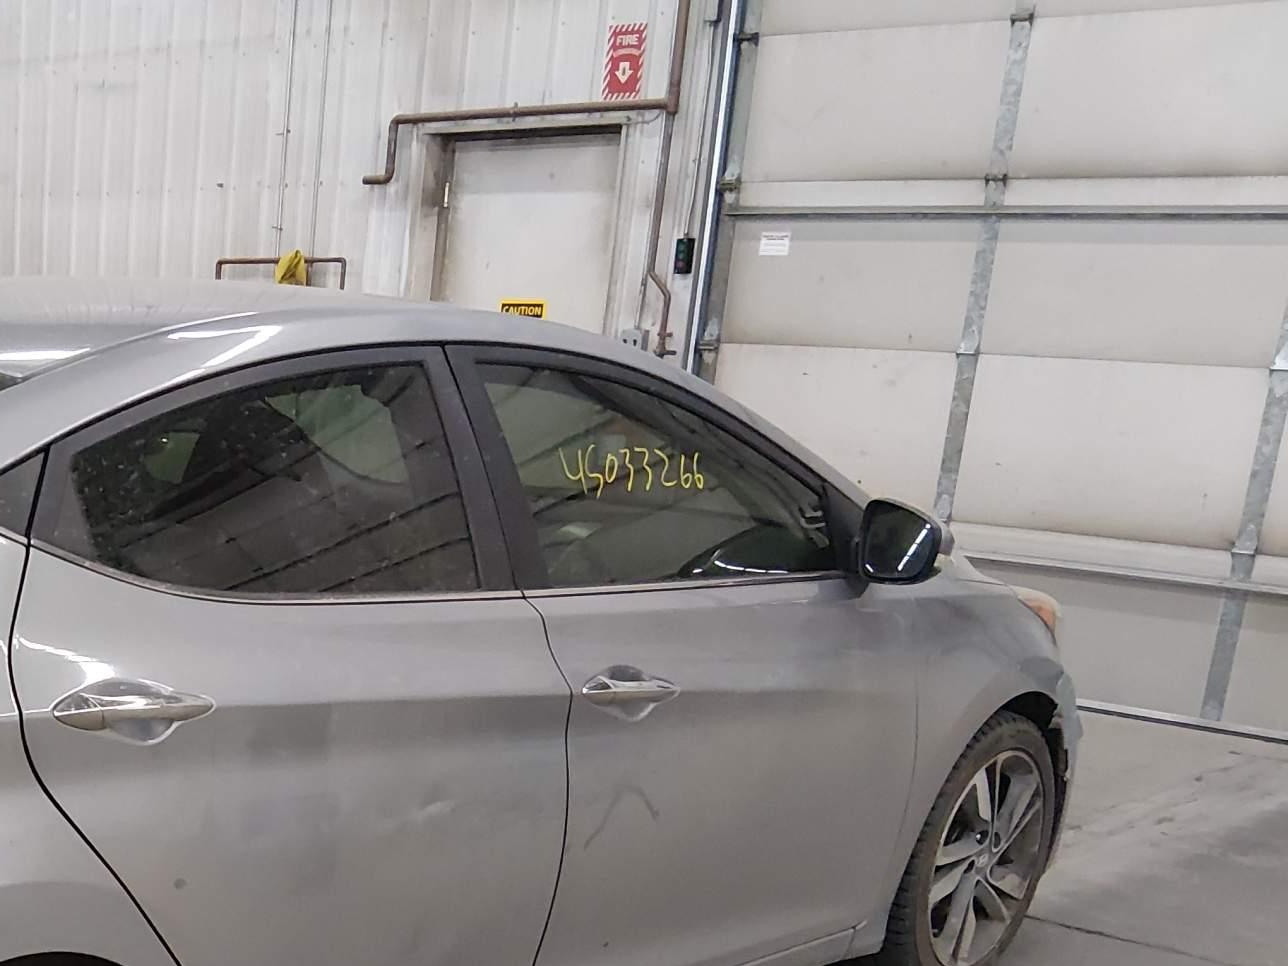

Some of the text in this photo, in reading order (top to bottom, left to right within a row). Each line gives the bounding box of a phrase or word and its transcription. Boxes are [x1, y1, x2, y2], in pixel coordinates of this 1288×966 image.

[616, 33, 639, 46] FIRE
[503, 305, 542, 316] CAUTION
[558, 444, 704, 499] 45033266
